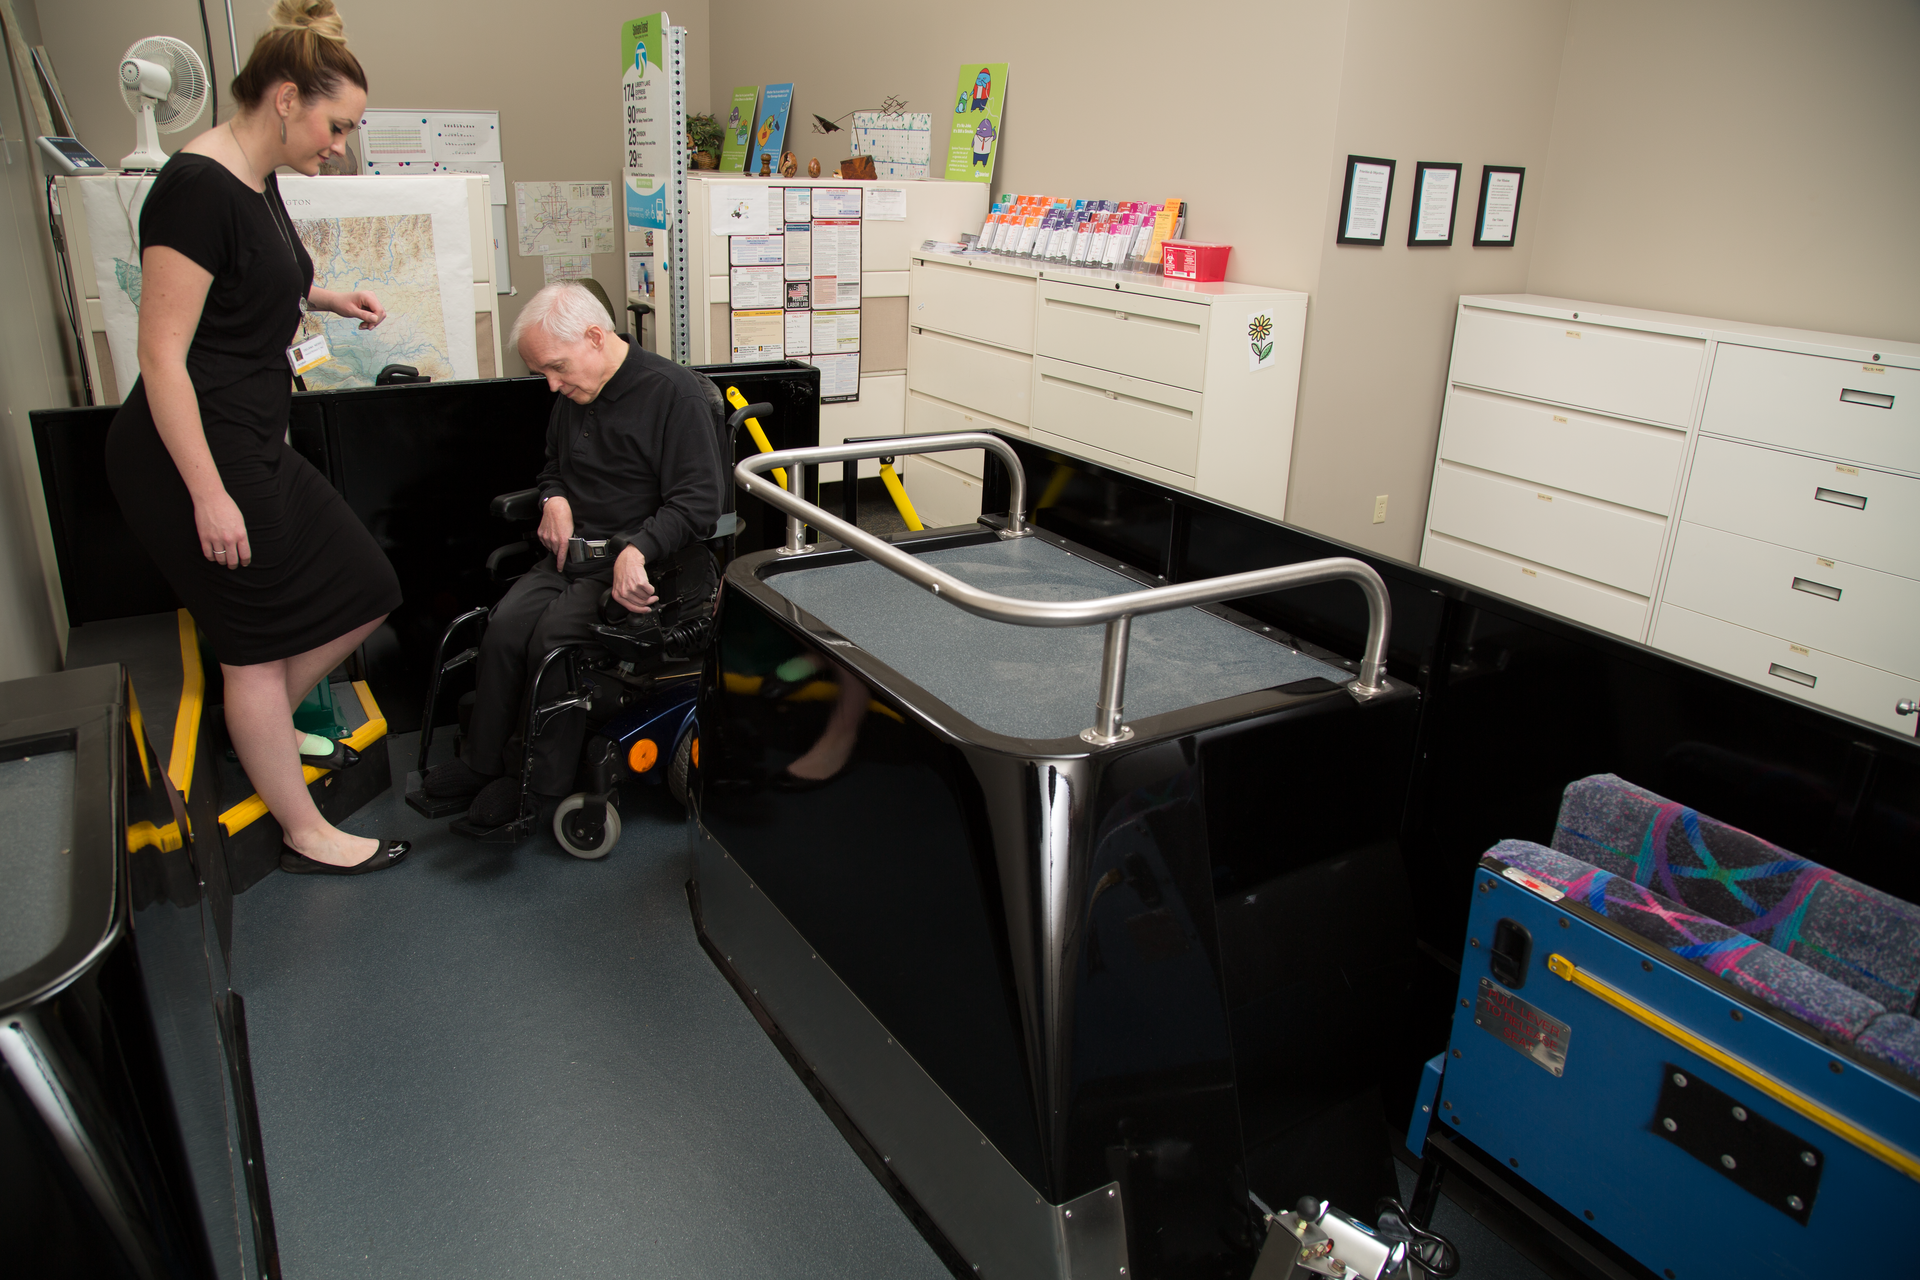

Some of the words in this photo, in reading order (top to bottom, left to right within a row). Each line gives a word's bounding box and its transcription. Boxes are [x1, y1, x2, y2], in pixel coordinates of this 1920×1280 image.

[623, 83, 635, 101] 174
[627, 105, 636, 124] 90
[628, 127, 637, 146] 25
[629, 149, 638, 168] 29
[1488, 988, 1517, 1013] PULL
[1520, 1007, 1560, 1038] LEVER
[1485, 1000, 1501, 1017] TO
[1503, 1012, 1559, 1052] RELEASE
[1503, 1027, 1535, 1051] SEAT
